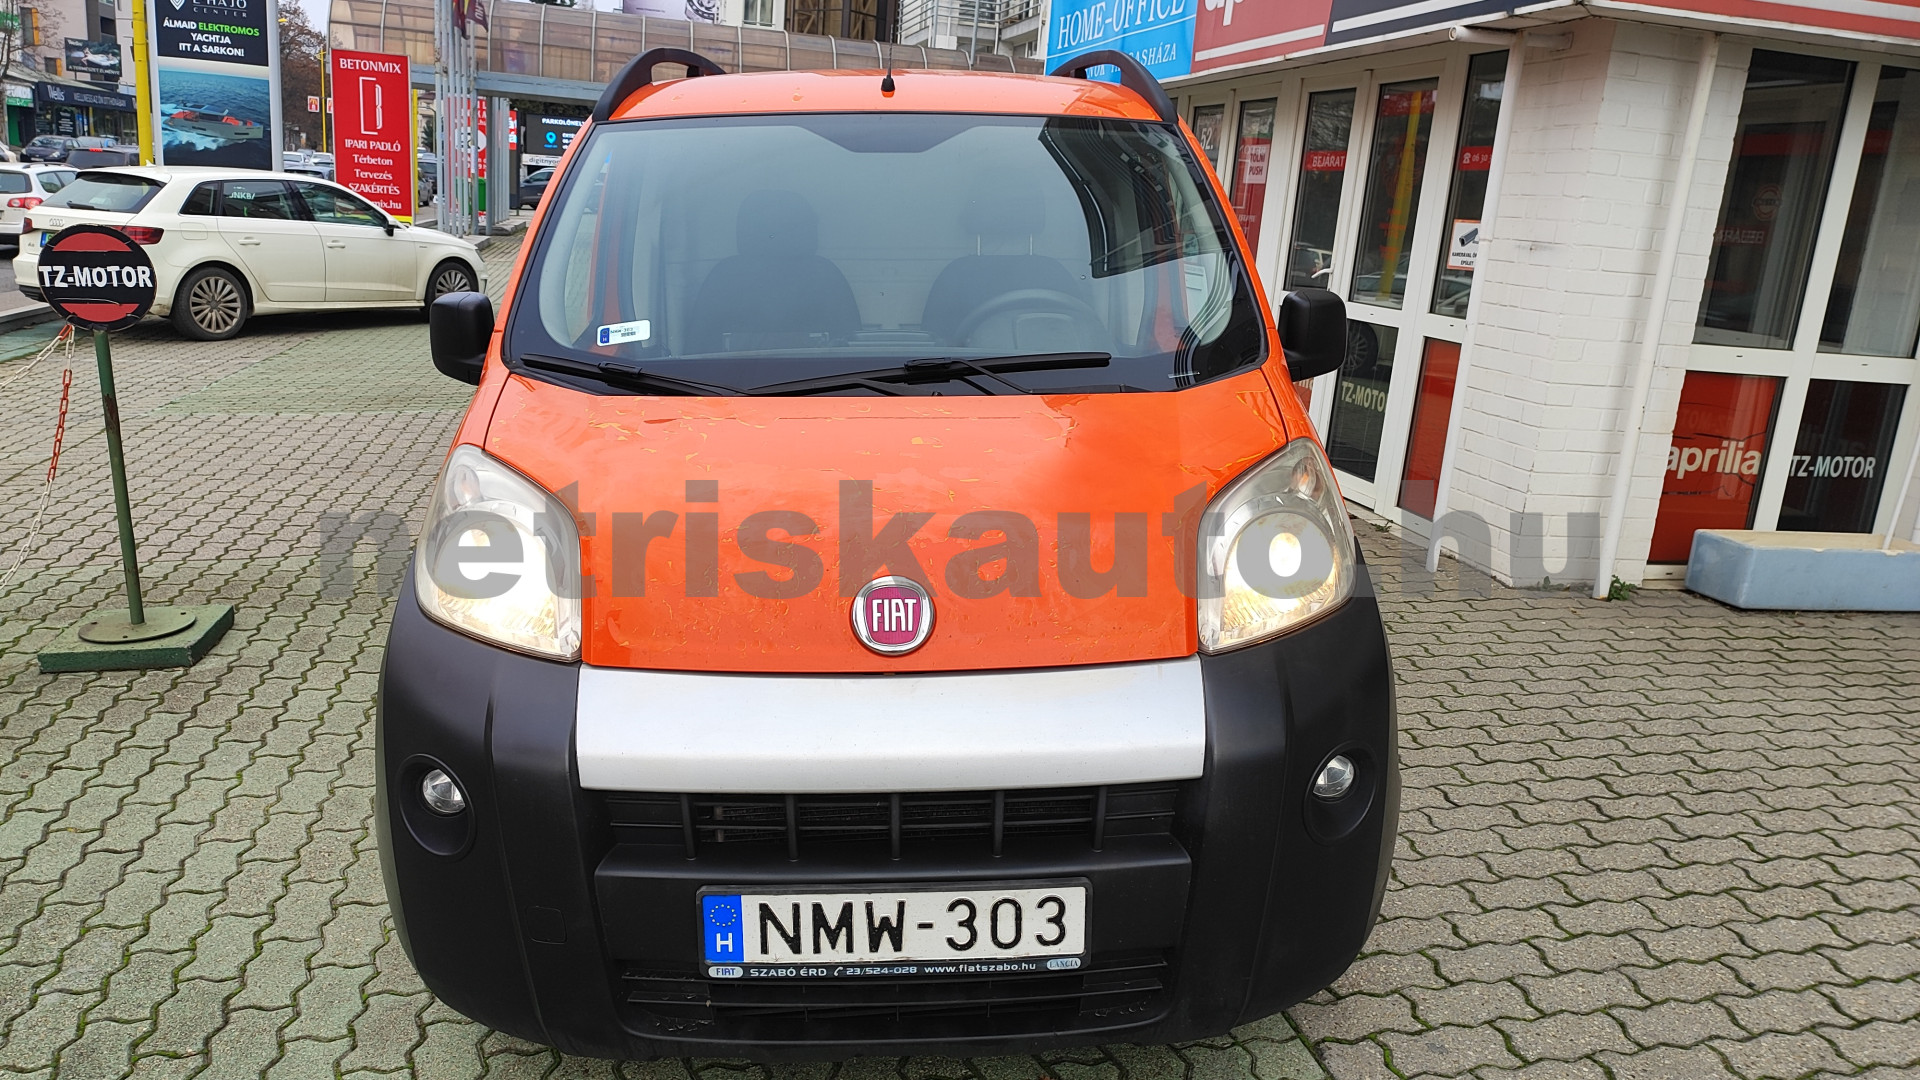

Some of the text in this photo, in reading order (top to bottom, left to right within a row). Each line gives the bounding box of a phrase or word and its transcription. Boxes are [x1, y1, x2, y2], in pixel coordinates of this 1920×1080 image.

[193, 7, 247, 18] CENTER
[163, 17, 260, 36] ÁLMAID ELEKTROMOS
[190, 33, 232, 44] YACHTJA
[179, 42, 192, 52] ITT
[193, 45, 201, 53] A
[339, 58, 402, 74] BETONMIX
[344, 139, 401, 152] IPARI PADLÓ
[352, 154, 393, 165] Térbeton
[1312, 153, 1346, 167] BEJÁRAT
[354, 169, 393, 180] Tervezés
[348, 182, 401, 195] SZAKÉRTÉS
[38, 265, 154, 288] TZ-MOTOR
[1341, 380, 1386, 412] TZ-MOTO
[1666, 440, 1762, 479] aprilia
[1789, 454, 1876, 478] TZ-MOTOR
[871, 598, 917, 632] FIAT
[758, 894, 1067, 956] NMW-303
[715, 932, 733, 953] H
[924, 962, 1036, 974] www.fiatszabo.hu
[1049, 959, 1079, 969] LANCIA
[716, 967, 736, 977] FIAT
[750, 966, 917, 977] SZABÓ ÉRD 23/524-028
